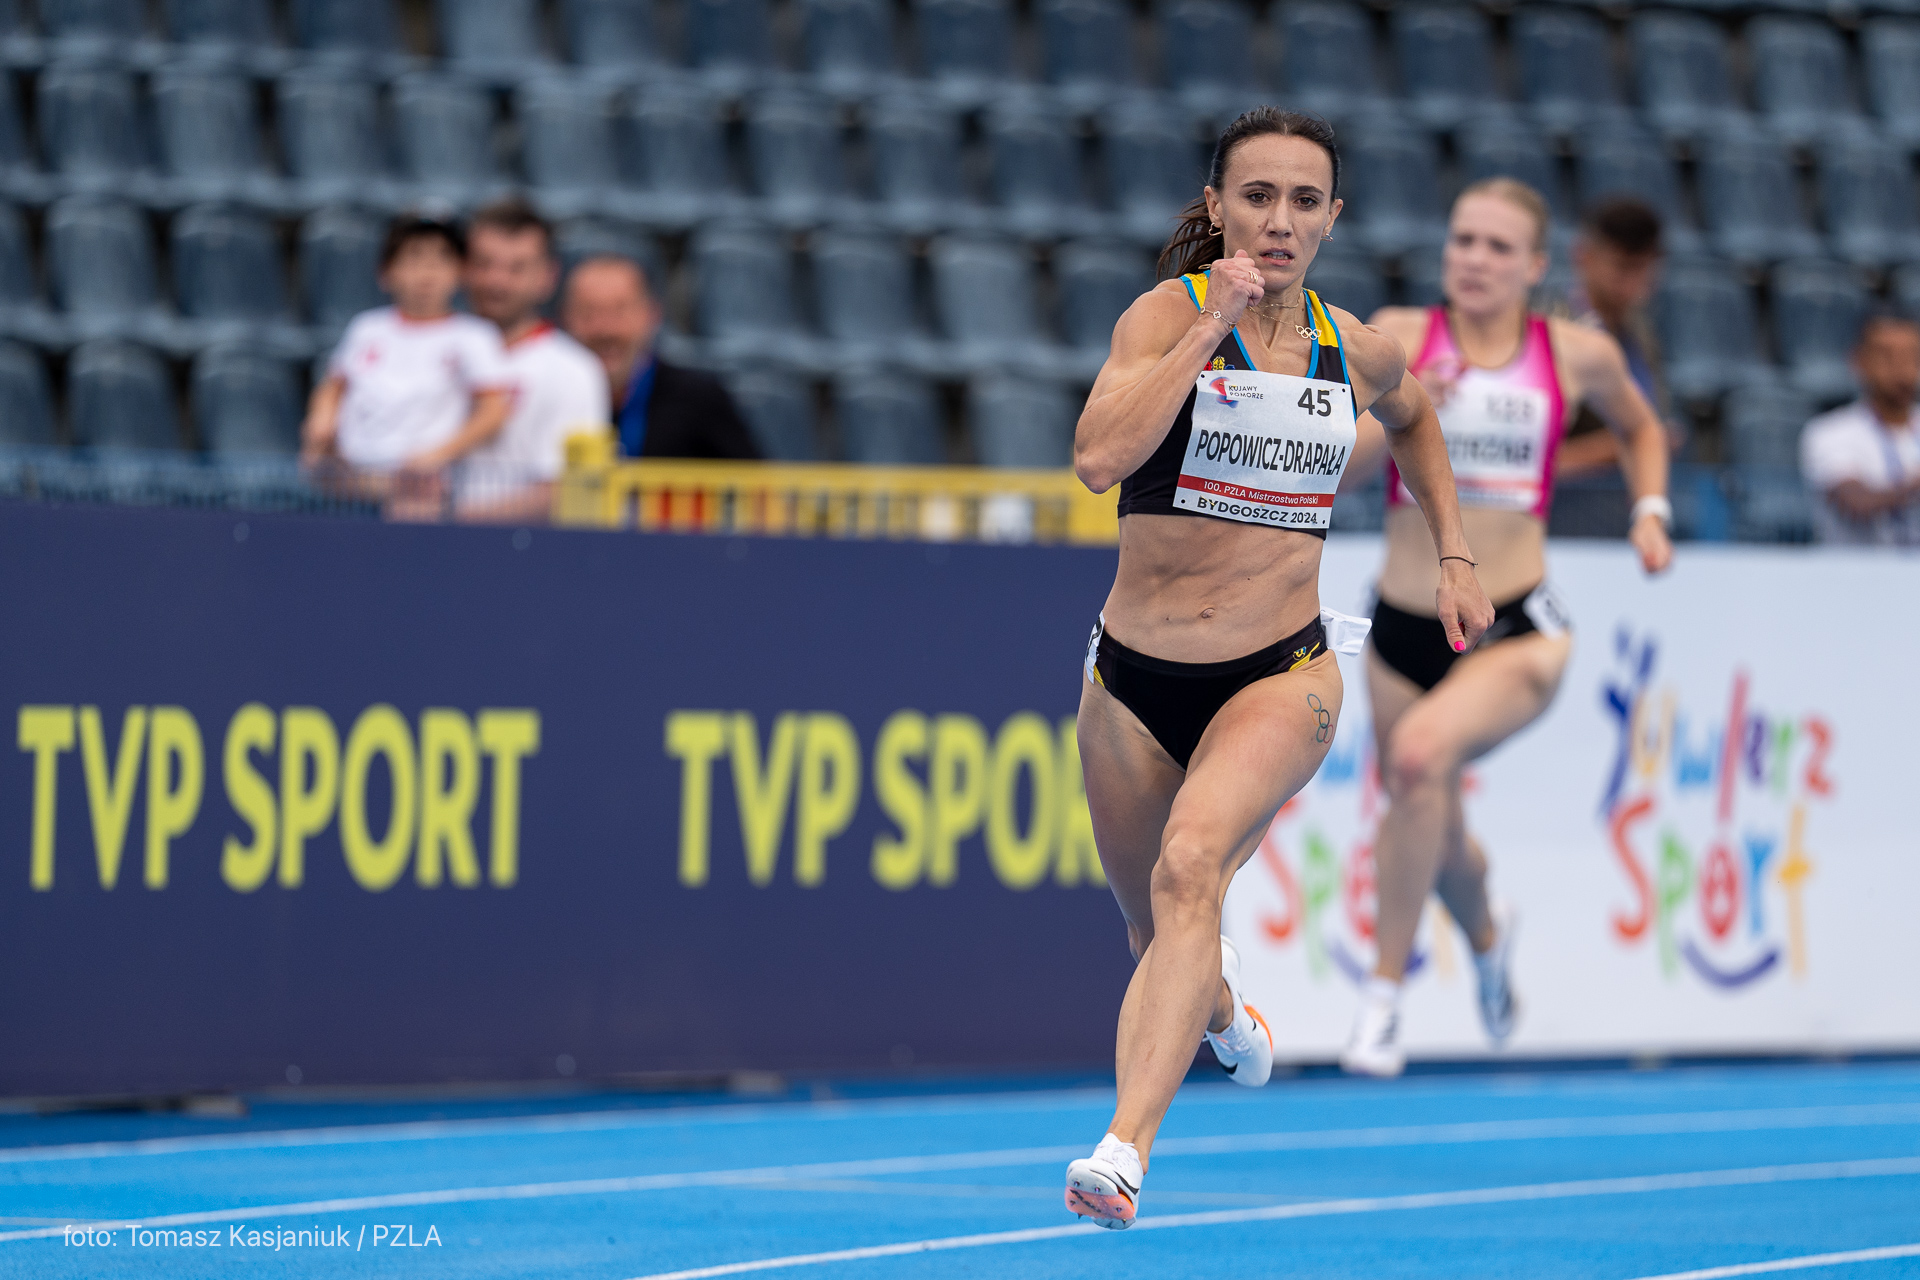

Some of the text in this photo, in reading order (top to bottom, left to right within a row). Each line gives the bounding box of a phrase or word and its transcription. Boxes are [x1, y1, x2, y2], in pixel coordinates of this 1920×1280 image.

[1229, 392, 1264, 400] POMORZE
[1297, 387, 1332, 417] 45
[1194, 429, 1346, 476] POPOWICZ-DRAPAŁA
[1203, 480, 1319, 505] 100. PZLA Mistrzostwa Polski
[1197, 496, 1289, 523] BYDGOSZCZ
[18, 702, 542, 893] TVP SPORT
[665, 709, 863, 889] TVP
[870, 708, 1110, 892] SPOR
